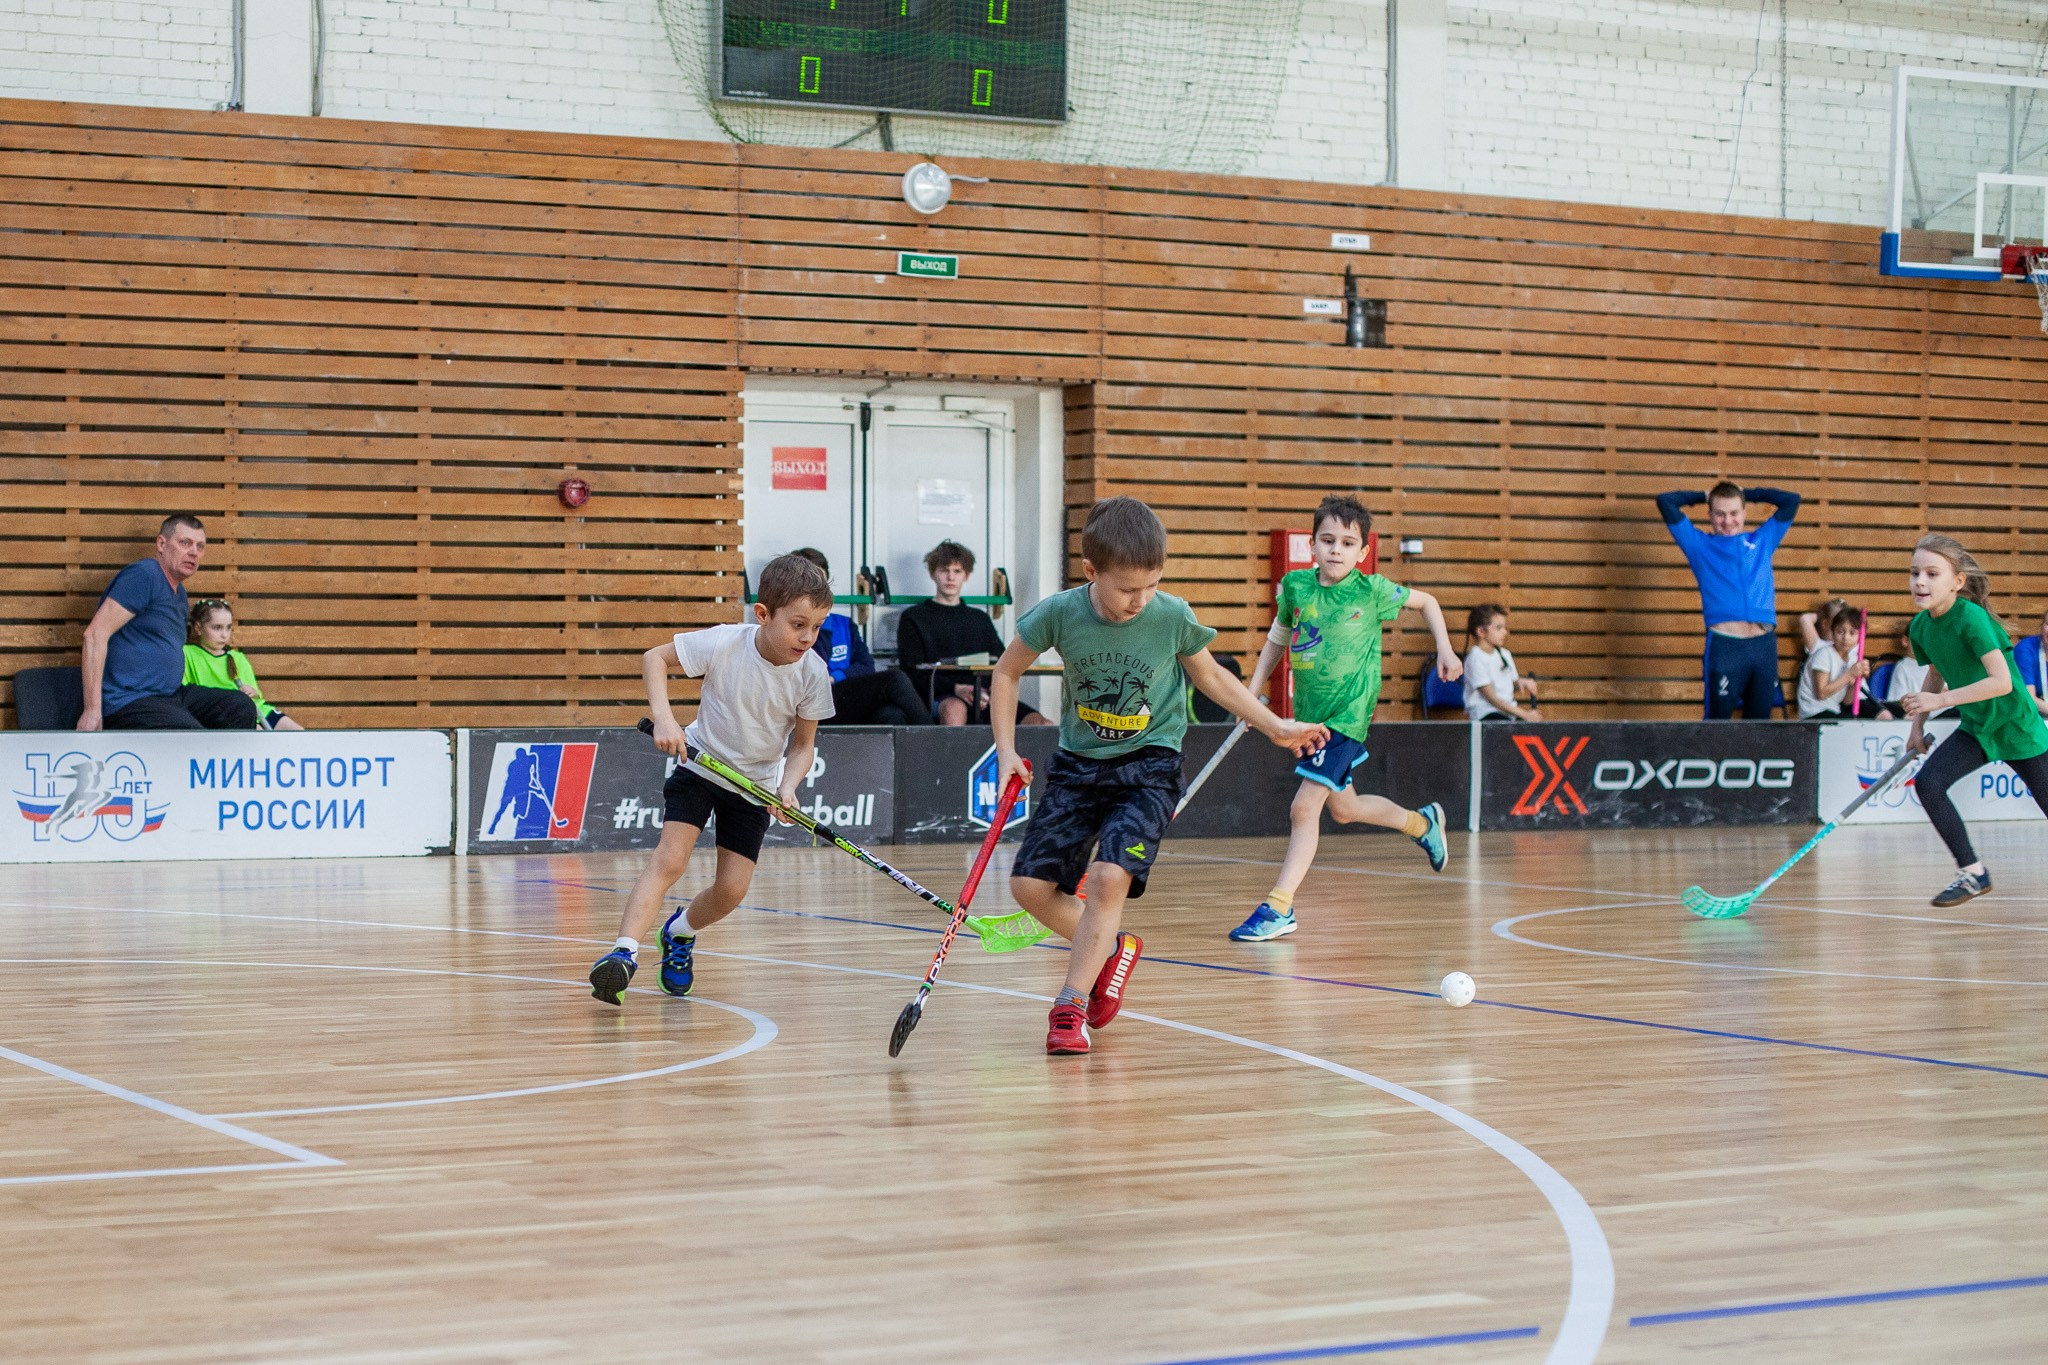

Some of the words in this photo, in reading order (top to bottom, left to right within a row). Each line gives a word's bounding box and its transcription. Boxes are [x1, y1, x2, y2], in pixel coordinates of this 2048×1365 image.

[800, 55, 821, 94] 0
[972, 69, 993, 107] 0
[910, 259, 948, 273] ВЫХОД
[773, 460, 827, 476] ВЫХОД
[1073, 652, 1155, 680] CRETACEOUS
[1082, 710, 1141, 727] ADVENTURE
[1095, 726, 1125, 739] PARK
[121, 780, 153, 795] ЛЕТ
[189, 756, 395, 790] МИНСПОРТ
[1593, 758, 1795, 790] OXDOG
[217, 798, 366, 831] РОССИИ
[929, 907, 966, 981] OXDOG
